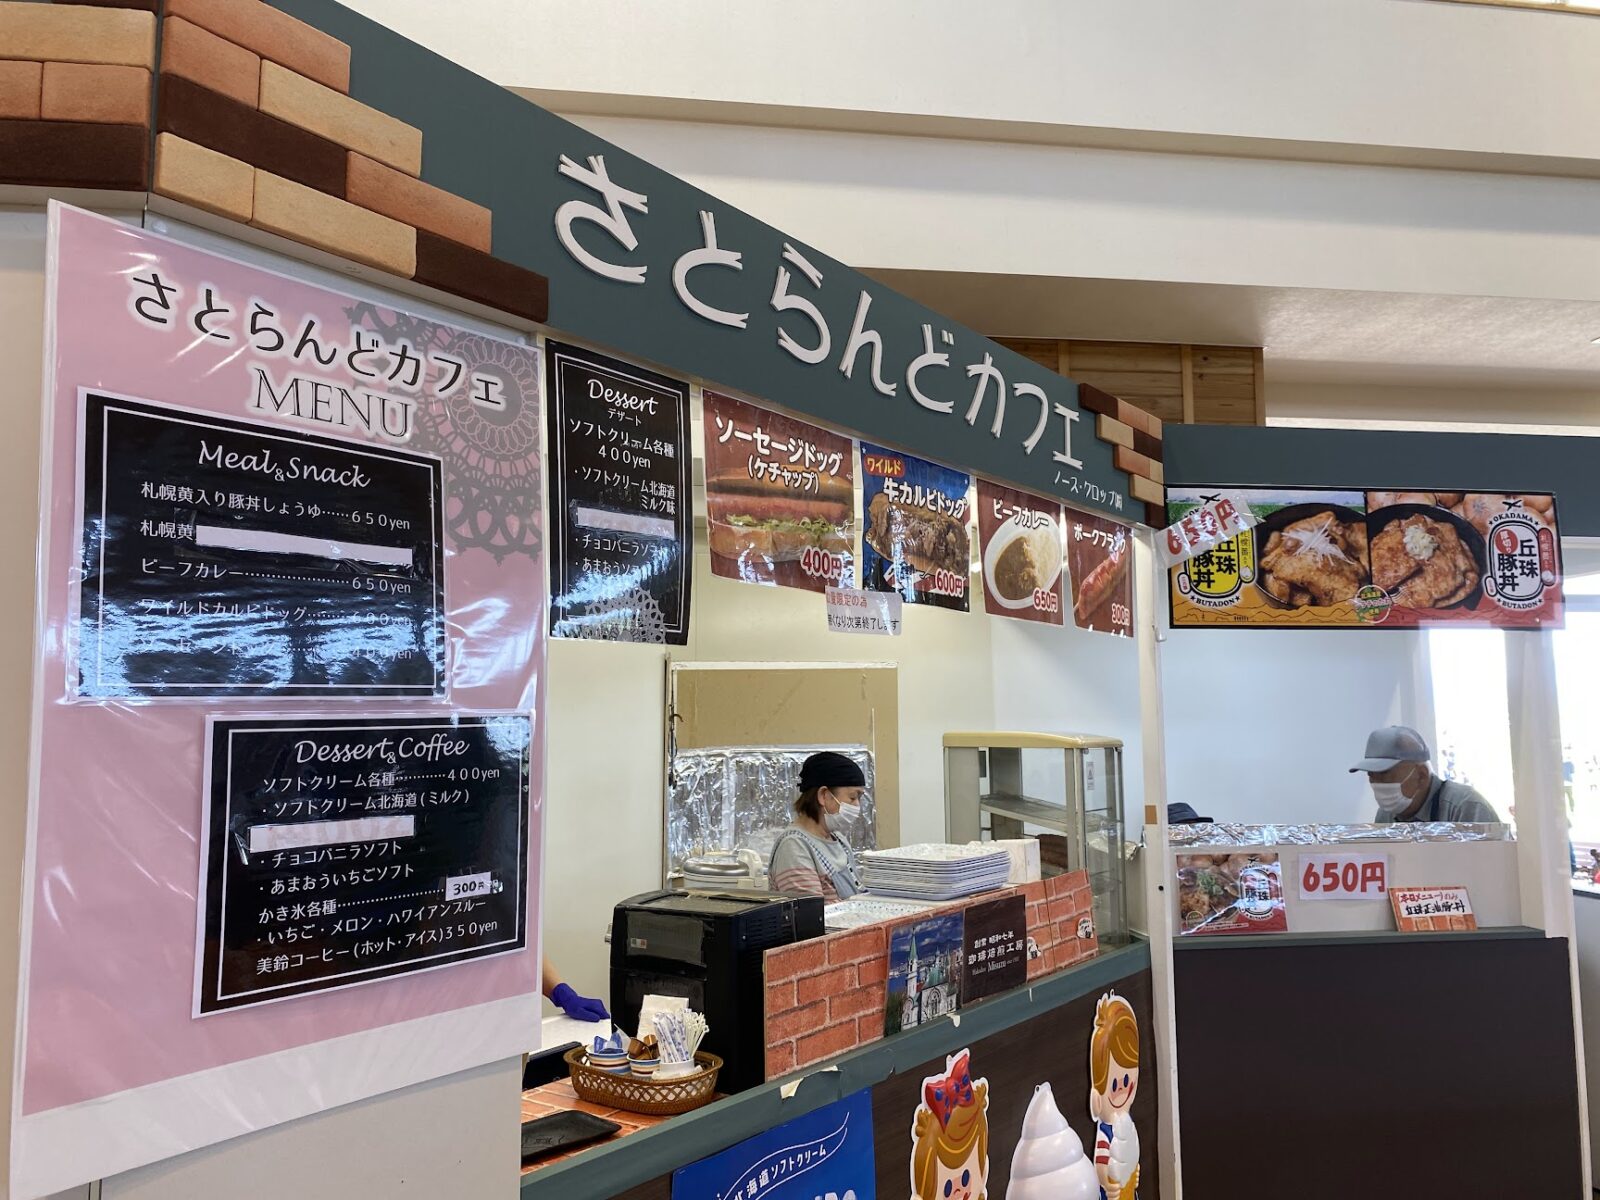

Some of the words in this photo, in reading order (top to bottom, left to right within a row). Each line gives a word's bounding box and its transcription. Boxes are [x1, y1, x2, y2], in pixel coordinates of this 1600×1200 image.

[555, 153, 1083, 470] さとらんどカフェ
[133, 272, 506, 406] さとらんどカフェ
[253, 367, 412, 438] MENU
[587, 379, 658, 416] Dessert
[608, 408, 641, 426] デザート
[569, 417, 674, 457] ソフトクリーム各種
[715, 416, 843, 476] ソーセージドッグ
[599, 447, 650, 469] 400yen
[866, 458, 903, 475] ワイルド
[748, 455, 819, 494] (ケチャップ)
[641, 494, 675, 515] ミルク味
[883, 477, 969, 519] 牛カルビドッグ
[993, 499, 1049, 529] ビーフカレー
[1493, 513, 1534, 523] OKADAMA
[140, 520, 193, 540] 札幌黄
[142, 558, 243, 579] ビーフカレー
[800, 546, 843, 579] 400円
[1498, 554, 1519, 592] 豚丼
[1518, 539, 1539, 578] 丘珠
[934, 569, 965, 597] 600円
[1033, 588, 1058, 613] 650円
[1196, 598, 1235, 608] BUTADON
[1502, 601, 1539, 610] BUTADON
[263, 771, 395, 793] ソフトクリーム各種
[1302, 862, 1385, 893] 650円
[259, 900, 337, 925] かき氷各種
